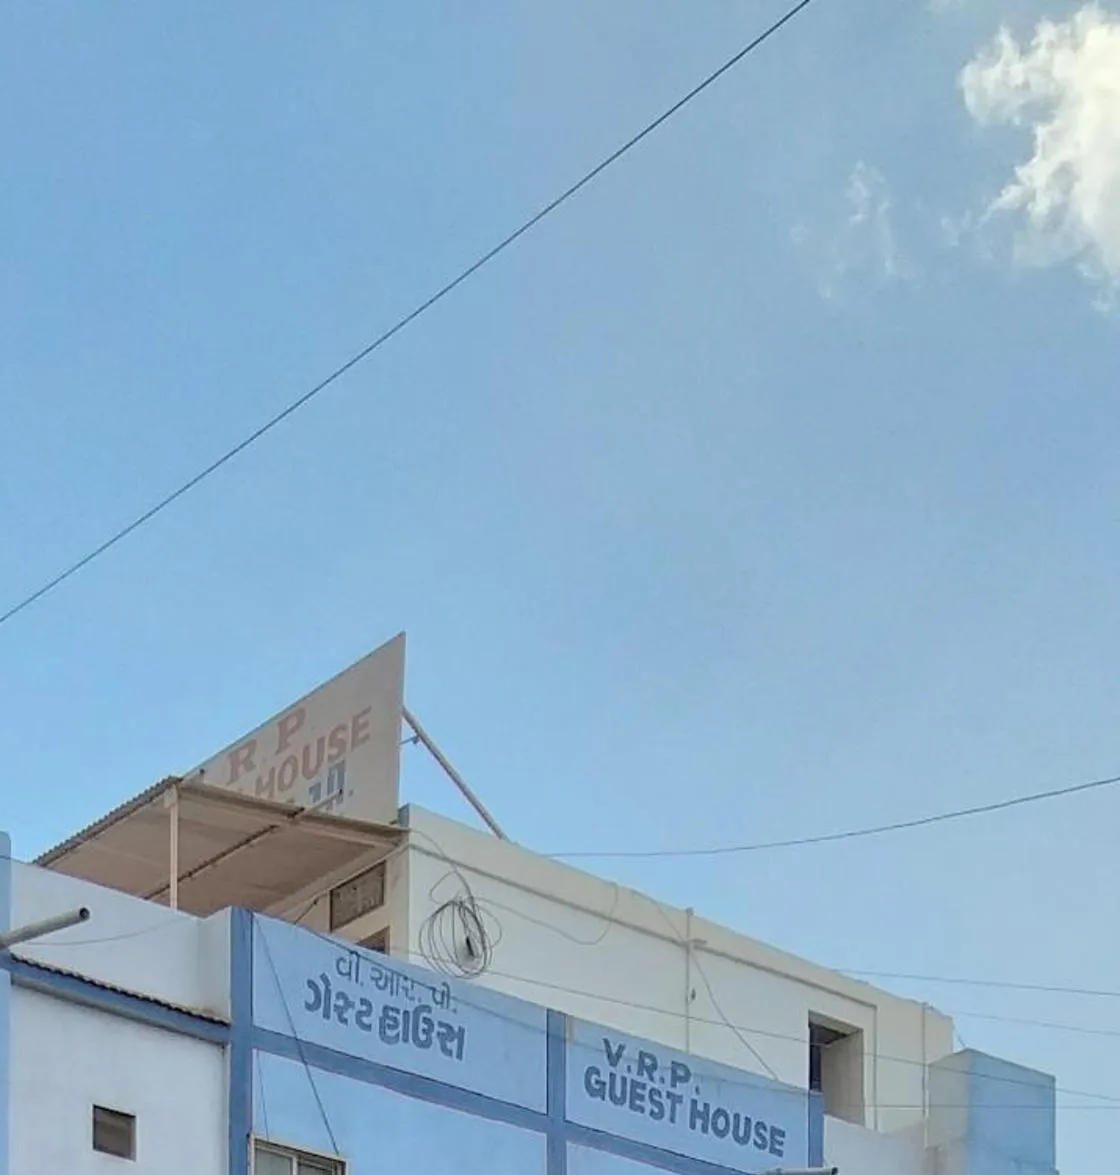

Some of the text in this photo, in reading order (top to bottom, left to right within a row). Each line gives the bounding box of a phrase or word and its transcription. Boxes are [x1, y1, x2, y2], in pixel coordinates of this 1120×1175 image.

[254, 705, 373, 800] HOUSE
[584, 1066, 786, 1158] GUEST HOUSE
[602, 1038, 700, 1095] V.R.P.
